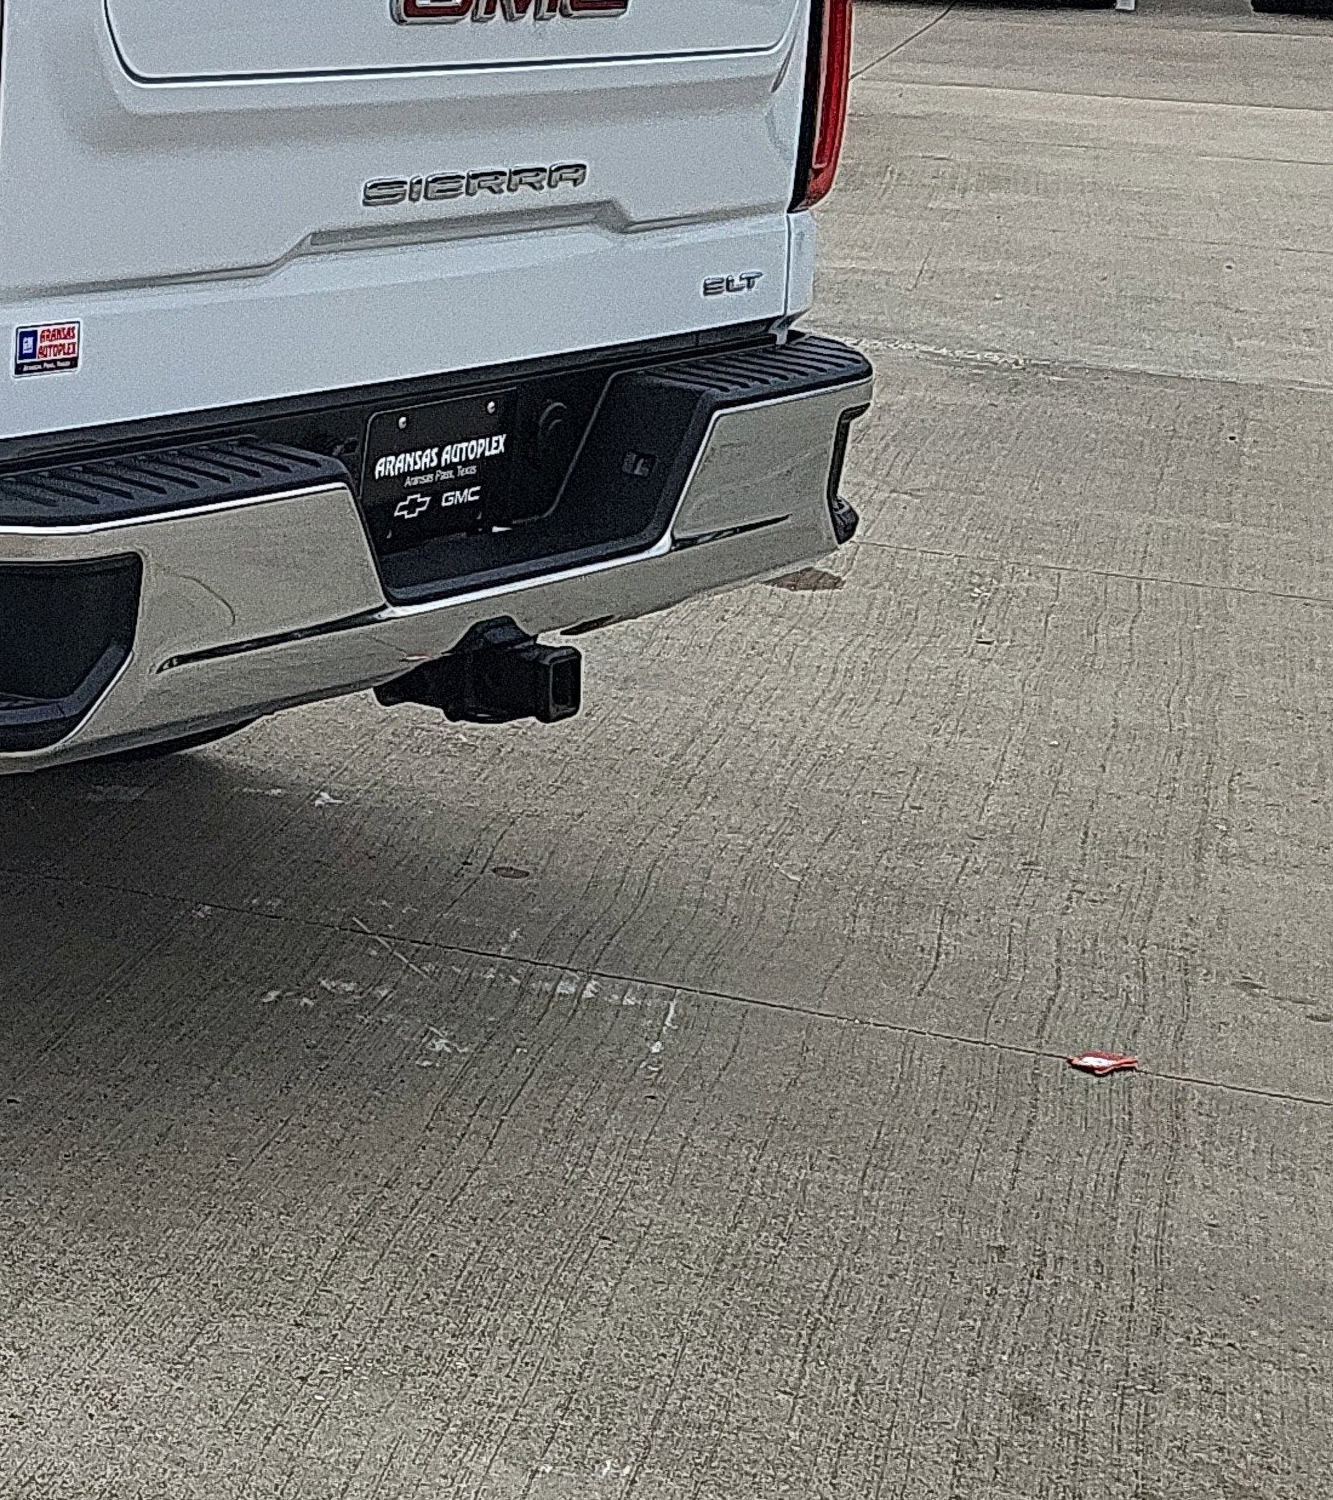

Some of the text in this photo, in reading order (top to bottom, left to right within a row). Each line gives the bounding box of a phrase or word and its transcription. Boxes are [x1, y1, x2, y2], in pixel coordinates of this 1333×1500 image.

[362, 162, 588, 207] SIERRA
[39, 326, 75, 344] ARANSAS
[37, 342, 76, 359] AUTOPLEX
[375, 434, 506, 480] ARANSAS AUTOPLEX
[441, 486, 481, 507] GMC
